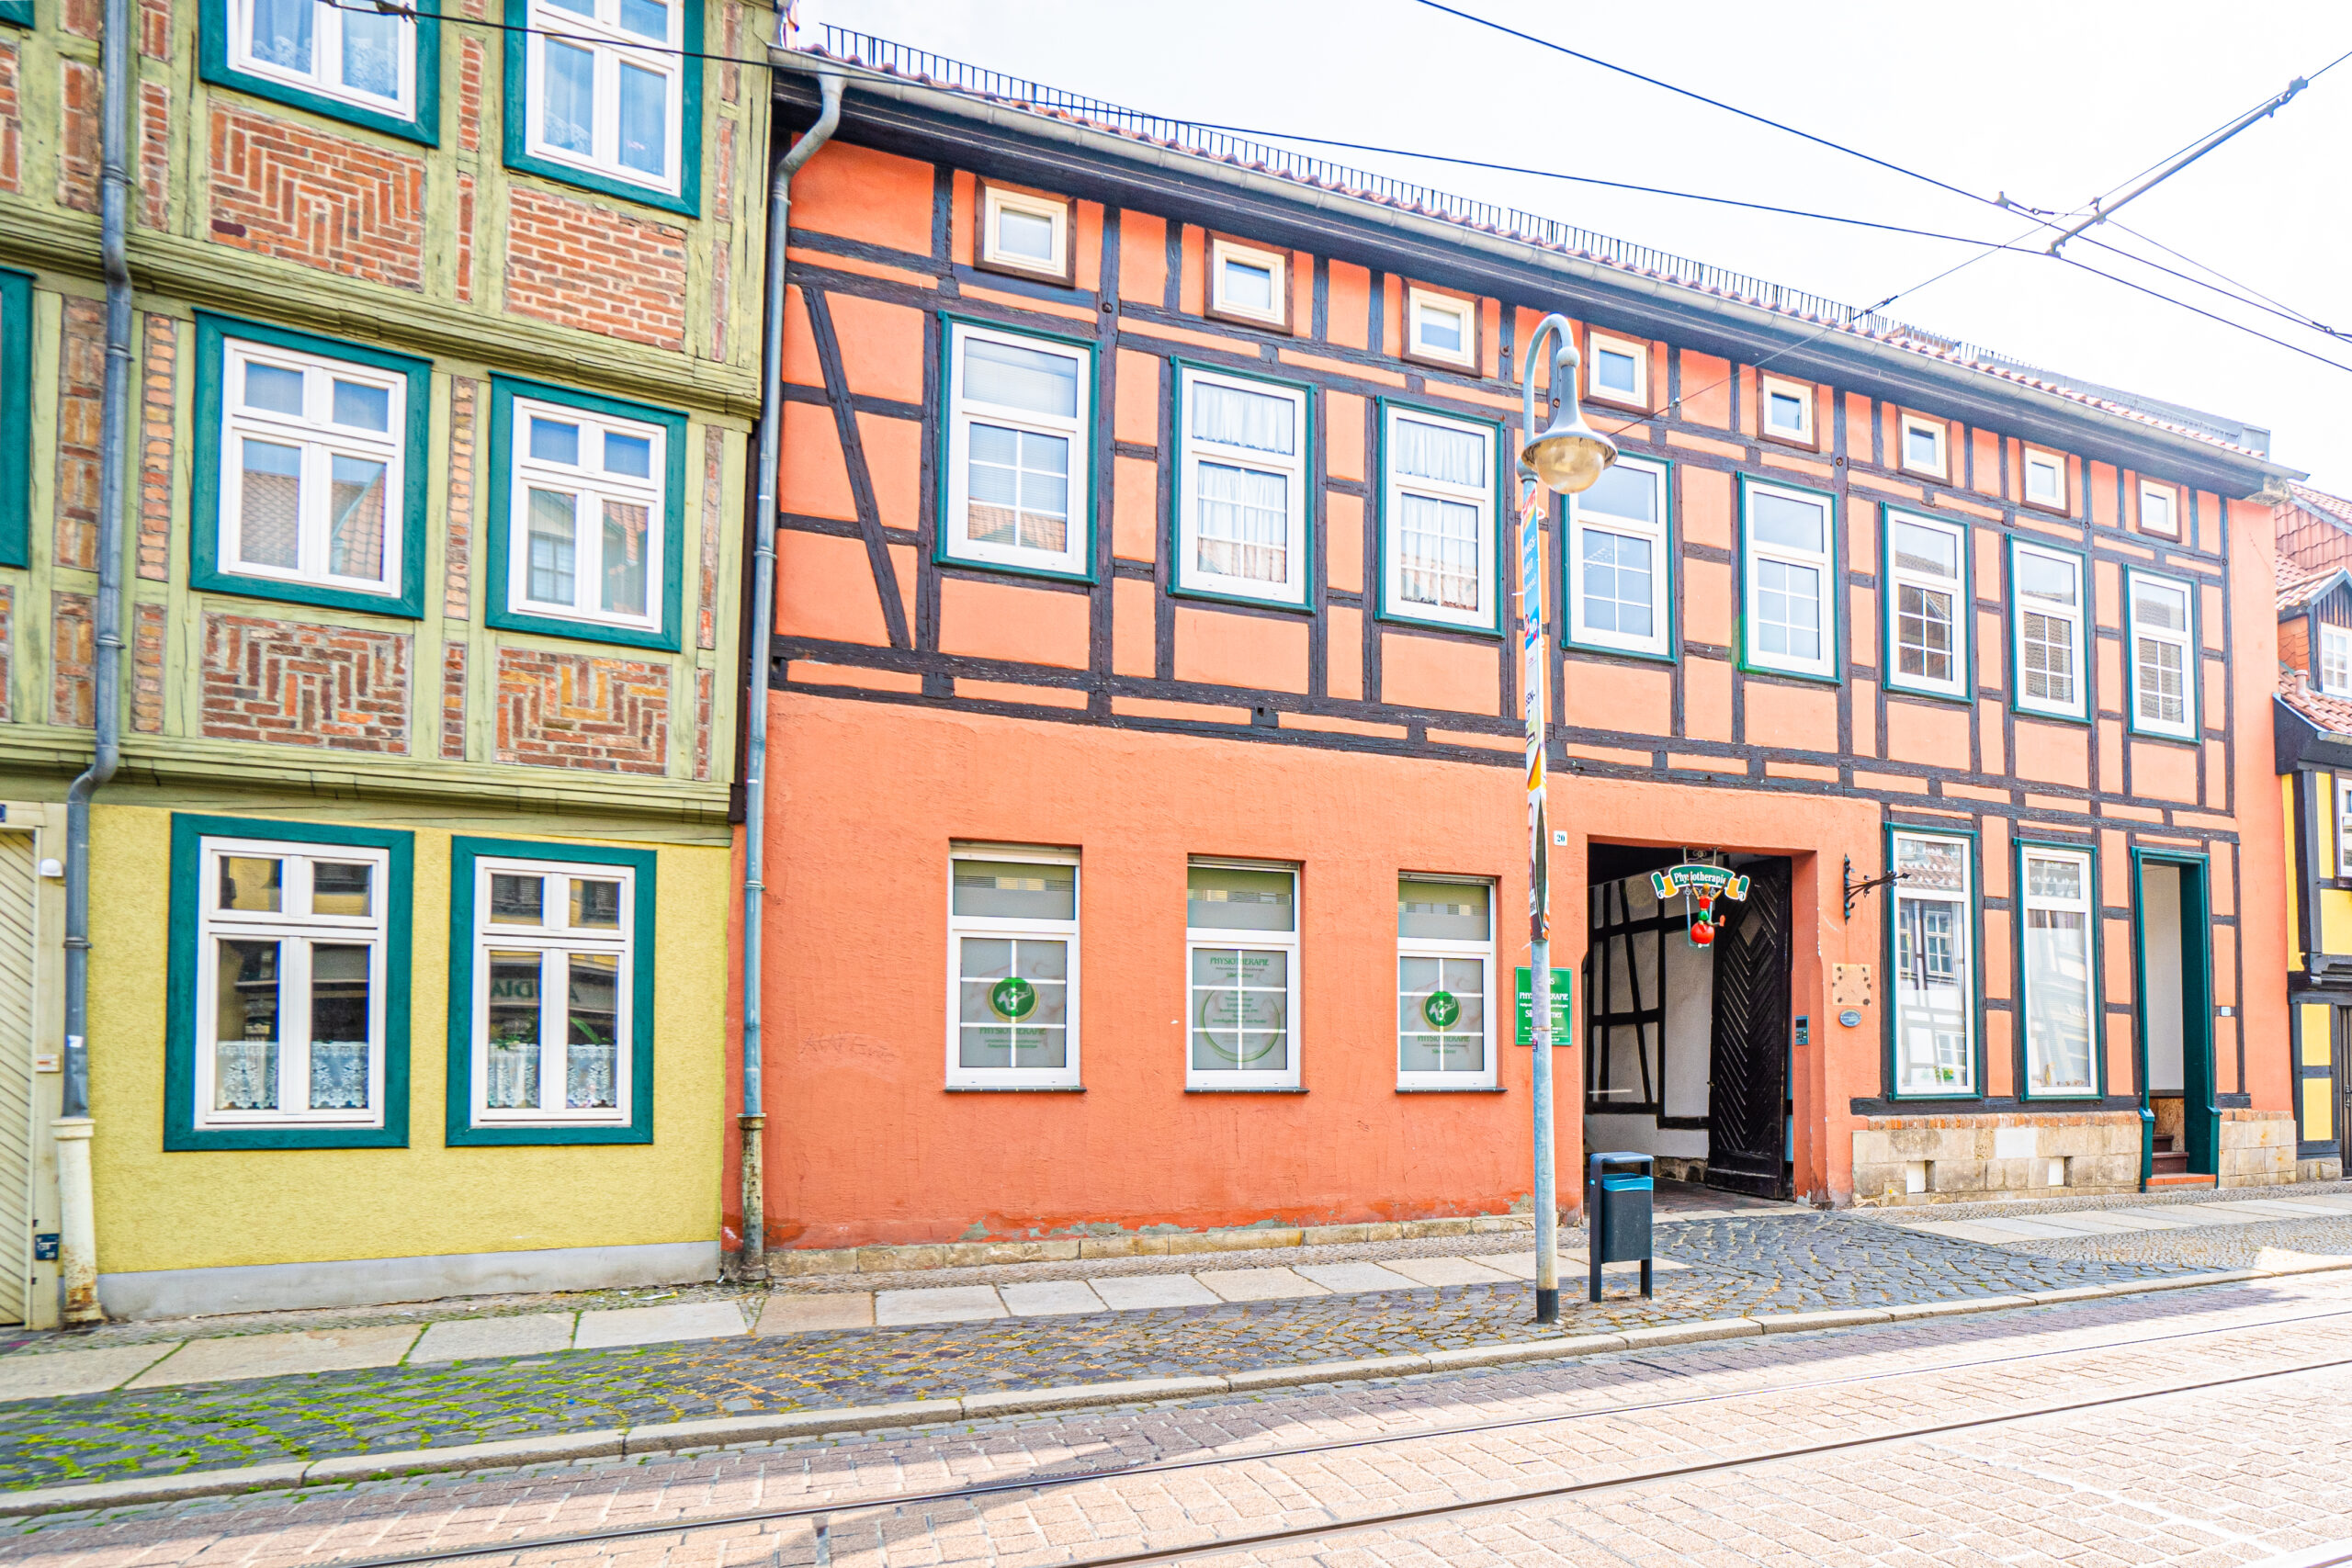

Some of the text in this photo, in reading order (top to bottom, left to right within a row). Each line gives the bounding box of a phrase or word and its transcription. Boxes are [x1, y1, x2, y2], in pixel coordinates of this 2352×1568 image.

[1556, 833, 1566, 842] 20
[1673, 871, 1726, 885] Physiotherapie
[1519, 992, 1568, 1000] PHYSRAPIE
